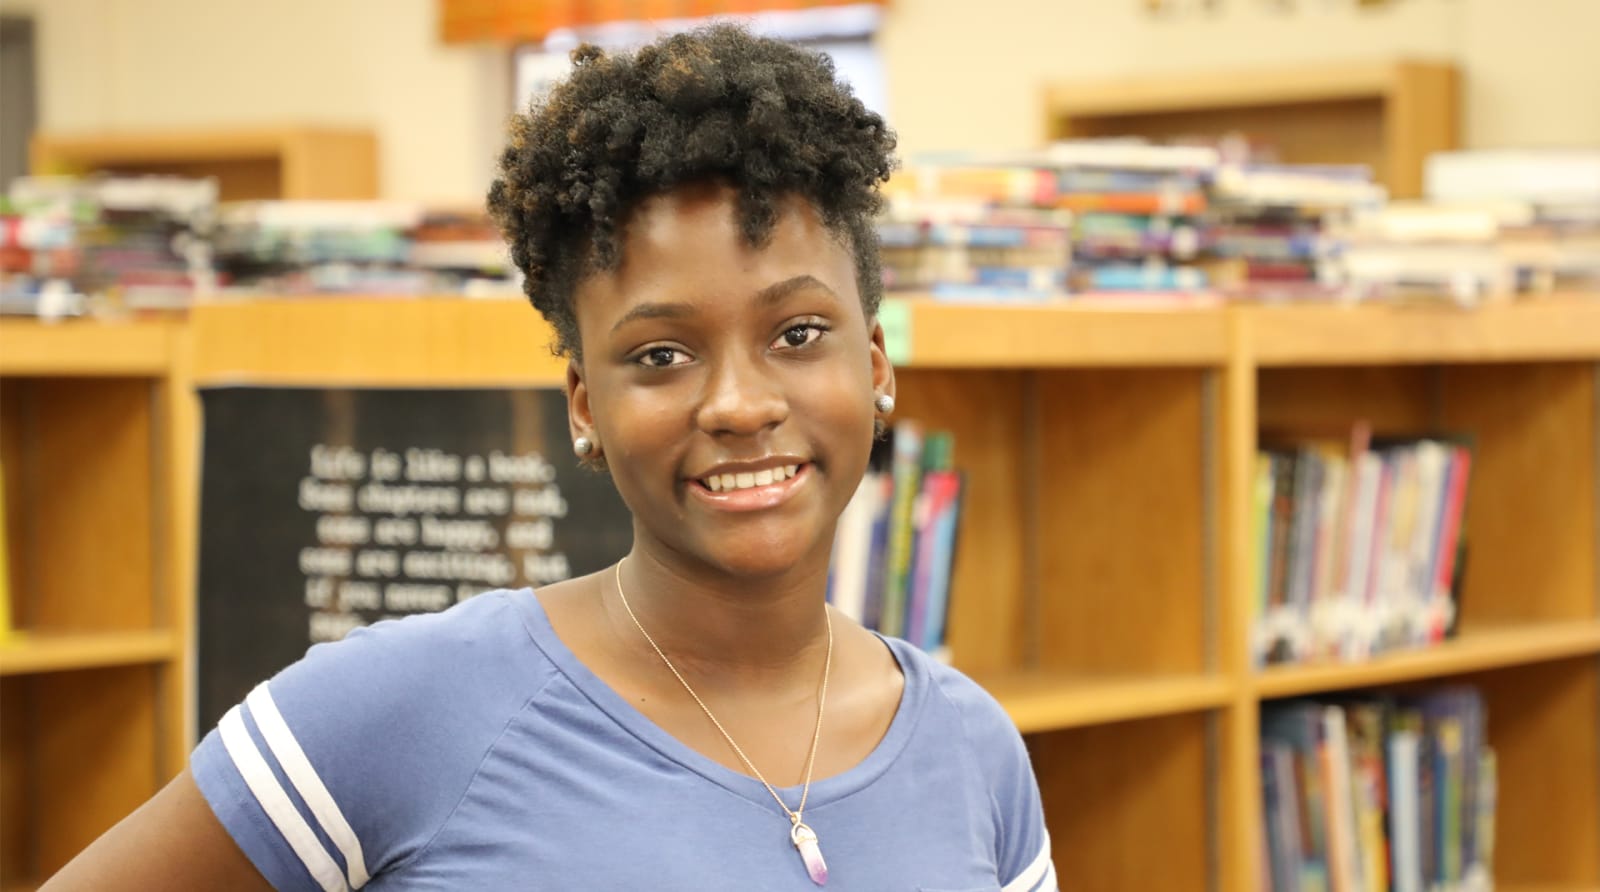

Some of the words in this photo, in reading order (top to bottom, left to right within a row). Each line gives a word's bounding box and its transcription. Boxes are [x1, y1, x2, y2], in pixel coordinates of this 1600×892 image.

[311, 446, 365, 480] Life
[405, 448, 460, 482] like
[465, 455, 486, 482] a
[464, 487, 510, 515] are
[374, 518, 418, 545] are
[356, 550, 399, 577] are
